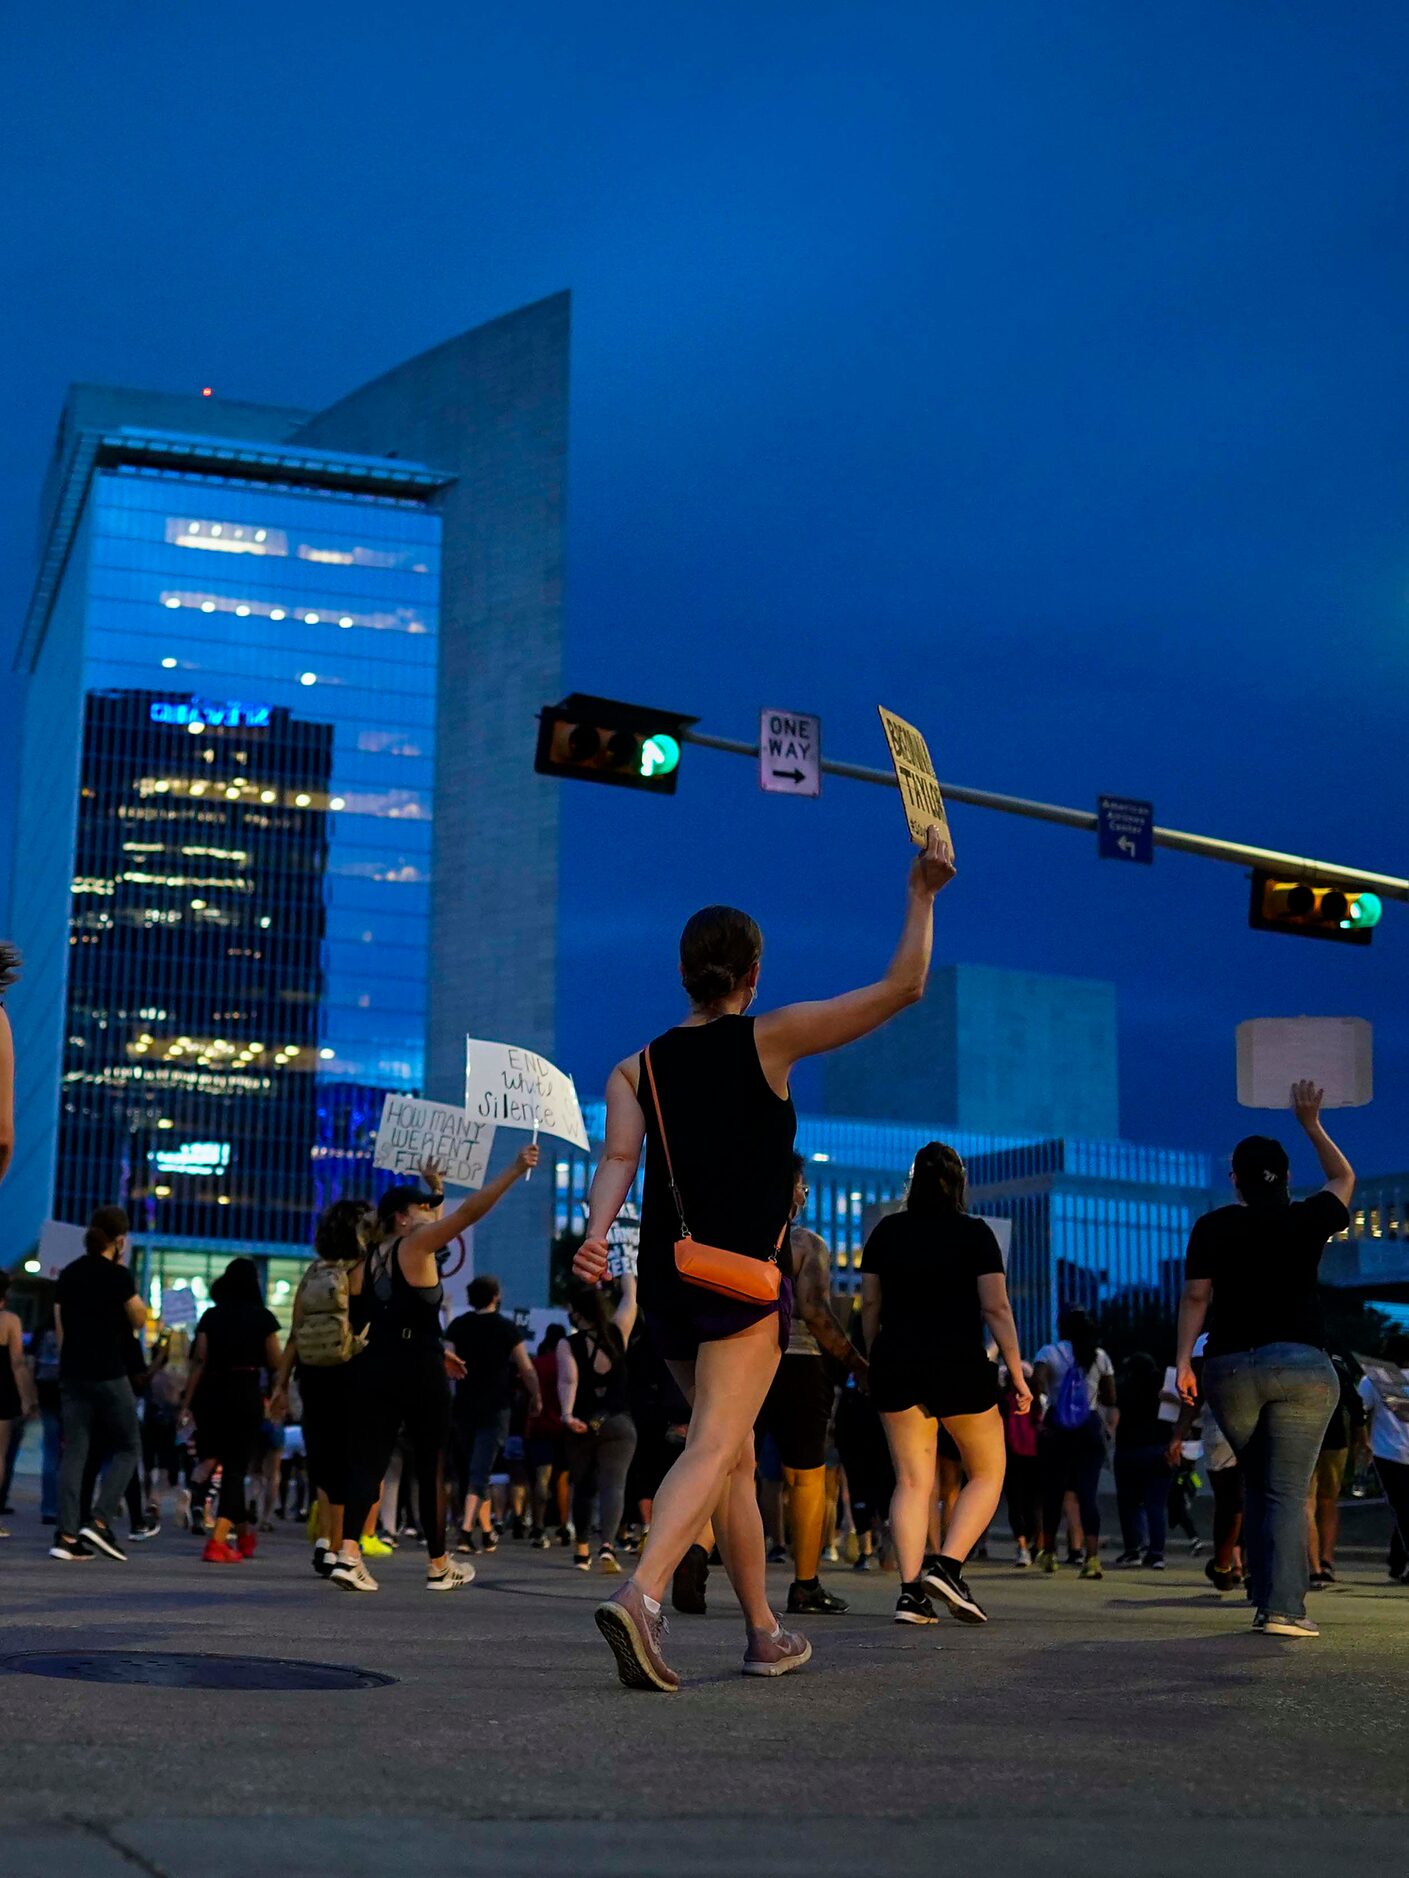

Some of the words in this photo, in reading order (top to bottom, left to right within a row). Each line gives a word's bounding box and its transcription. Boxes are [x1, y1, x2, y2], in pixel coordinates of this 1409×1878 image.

[769, 716, 811, 740] ONE
[768, 738, 811, 761] WAY
[508, 1049, 549, 1077] END
[387, 1101, 427, 1129] HOW
[429, 1110, 486, 1141] MANY
[478, 1091, 556, 1127] Silence
[395, 1151, 482, 1181] FIED?
